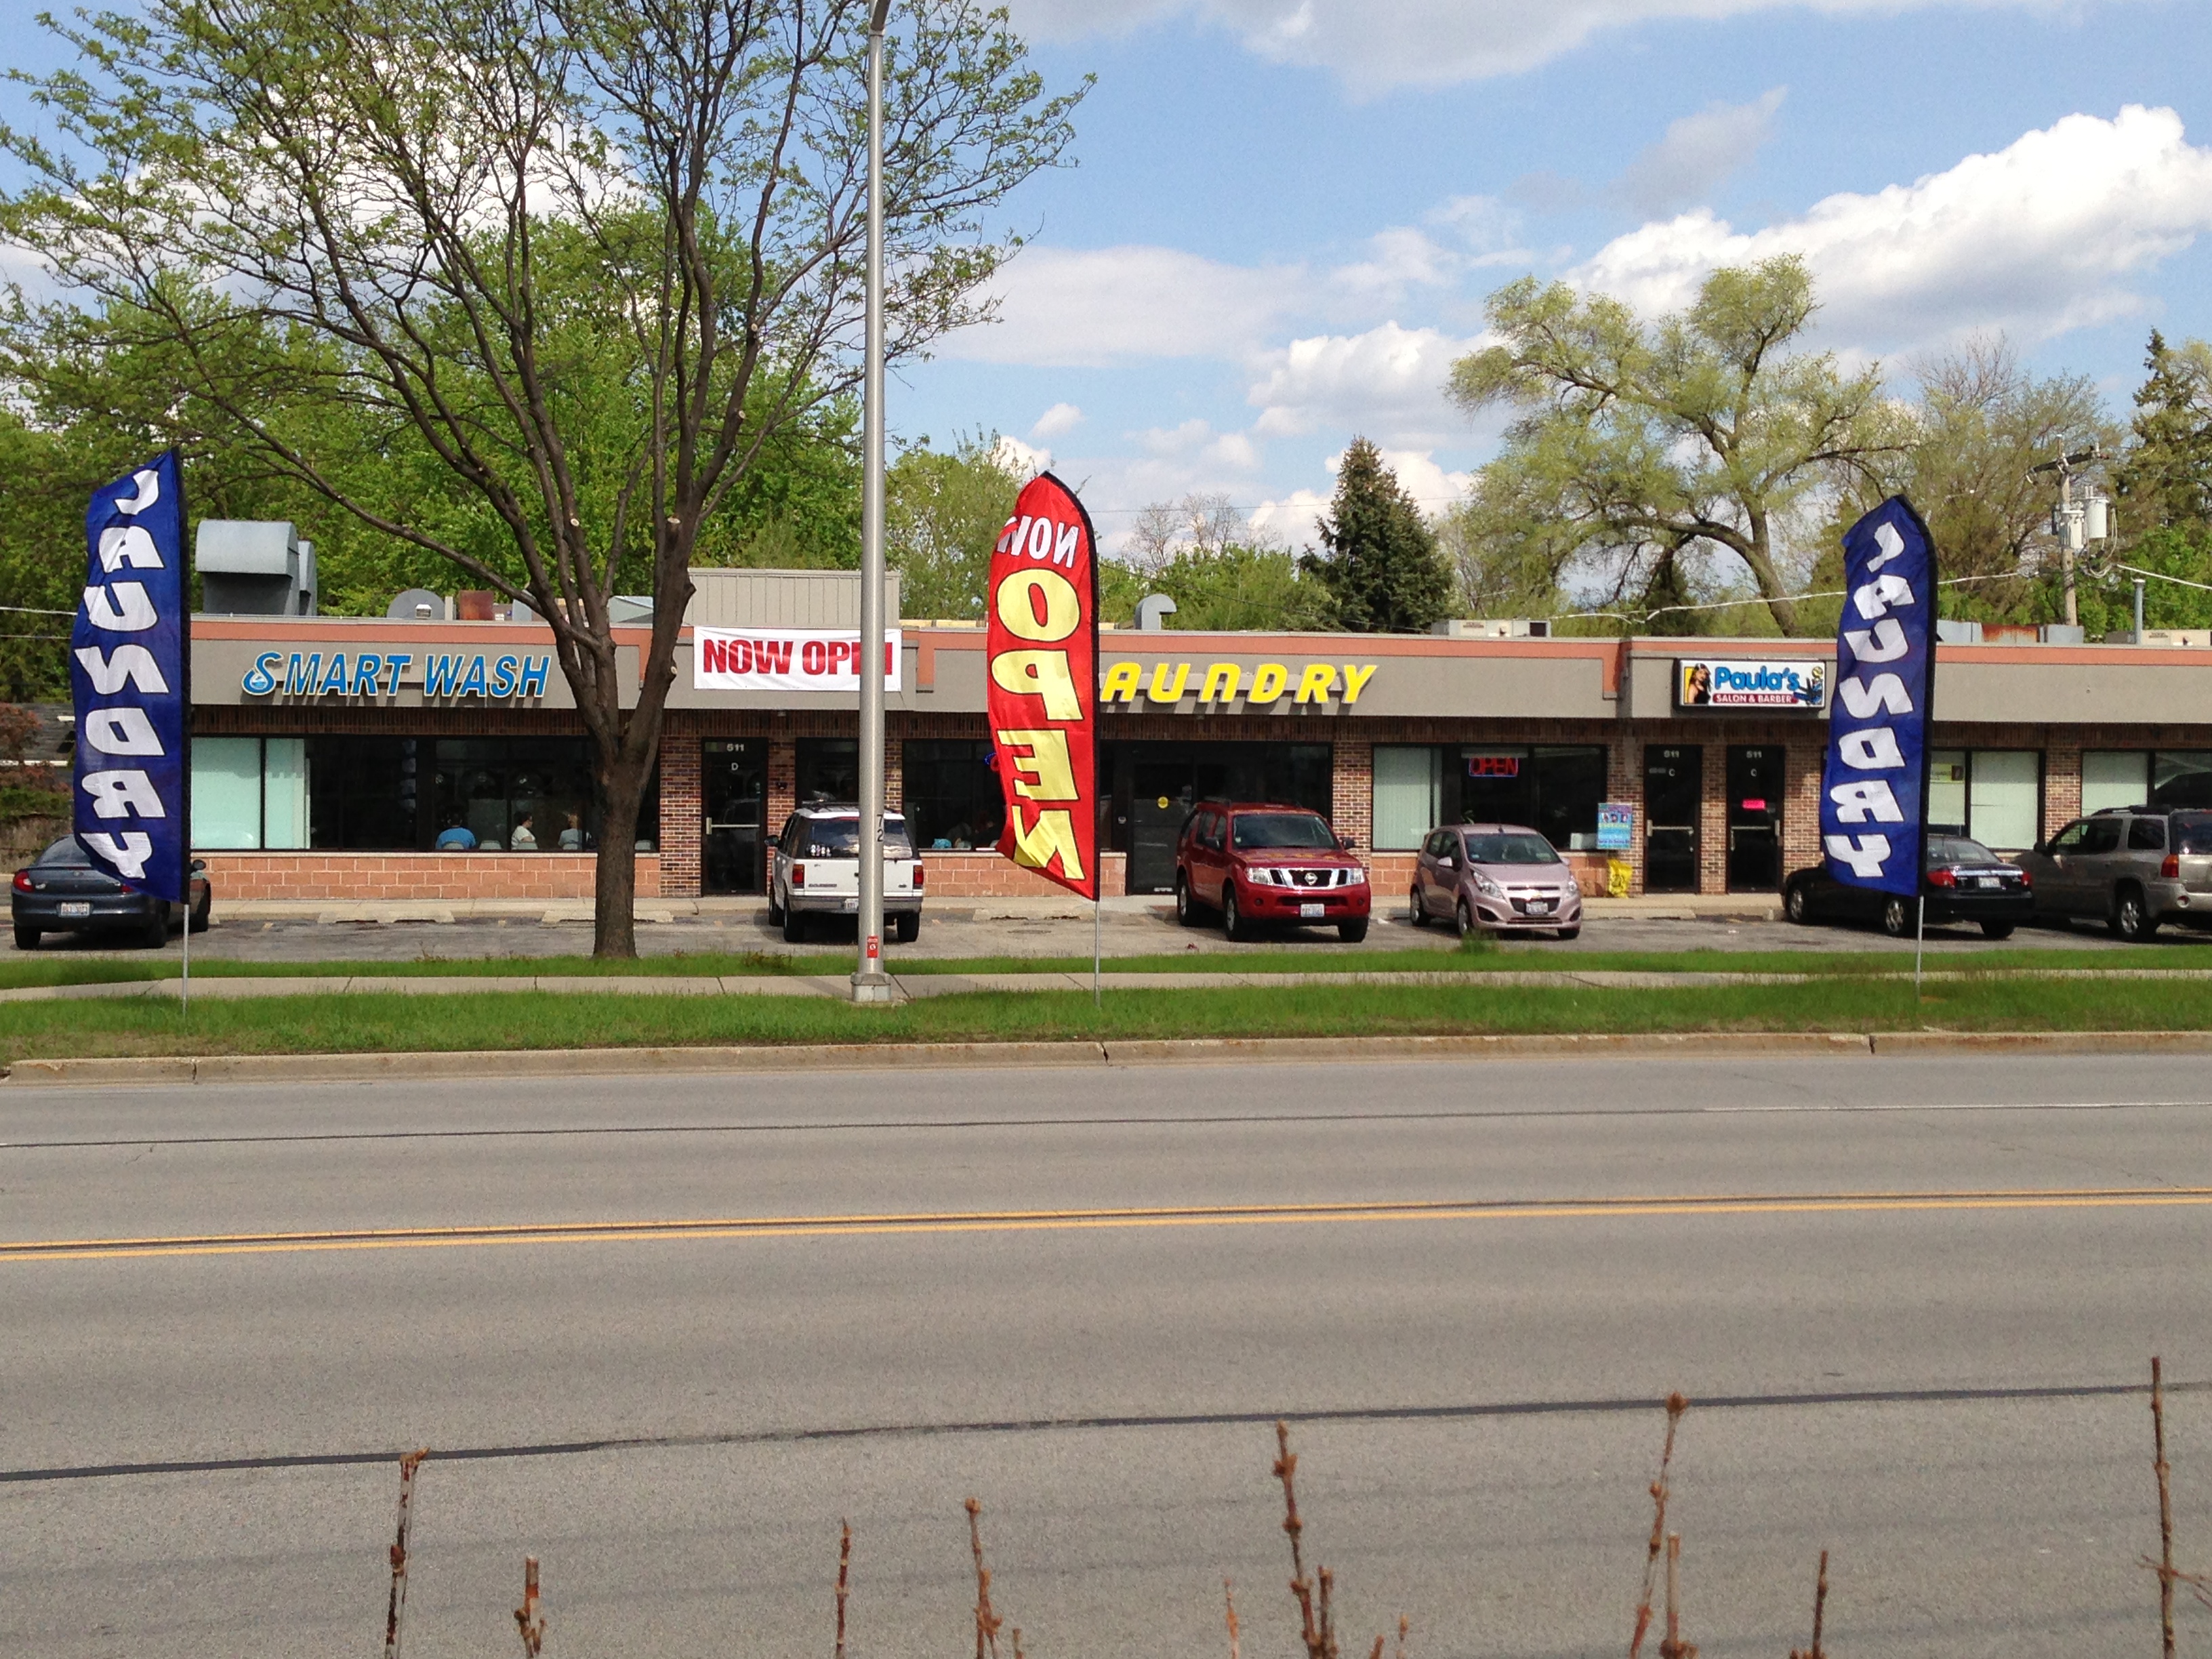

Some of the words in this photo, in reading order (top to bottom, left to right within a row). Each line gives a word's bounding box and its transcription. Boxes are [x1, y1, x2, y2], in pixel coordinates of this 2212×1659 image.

[703, 639, 794, 674] NOW
[242, 651, 413, 696] SMART
[424, 654, 552, 697] WASH
[1099, 661, 1377, 703] AUNDRY
[1715, 665, 1800, 691] Paula's
[1716, 694, 1744, 703] SALON
[1746, 694, 1755, 703] &
[1758, 695, 1792, 703] BARBER
[726, 743, 745, 752] 511
[731, 762, 739, 771] D
[1471, 757, 1517, 775] OPEN
